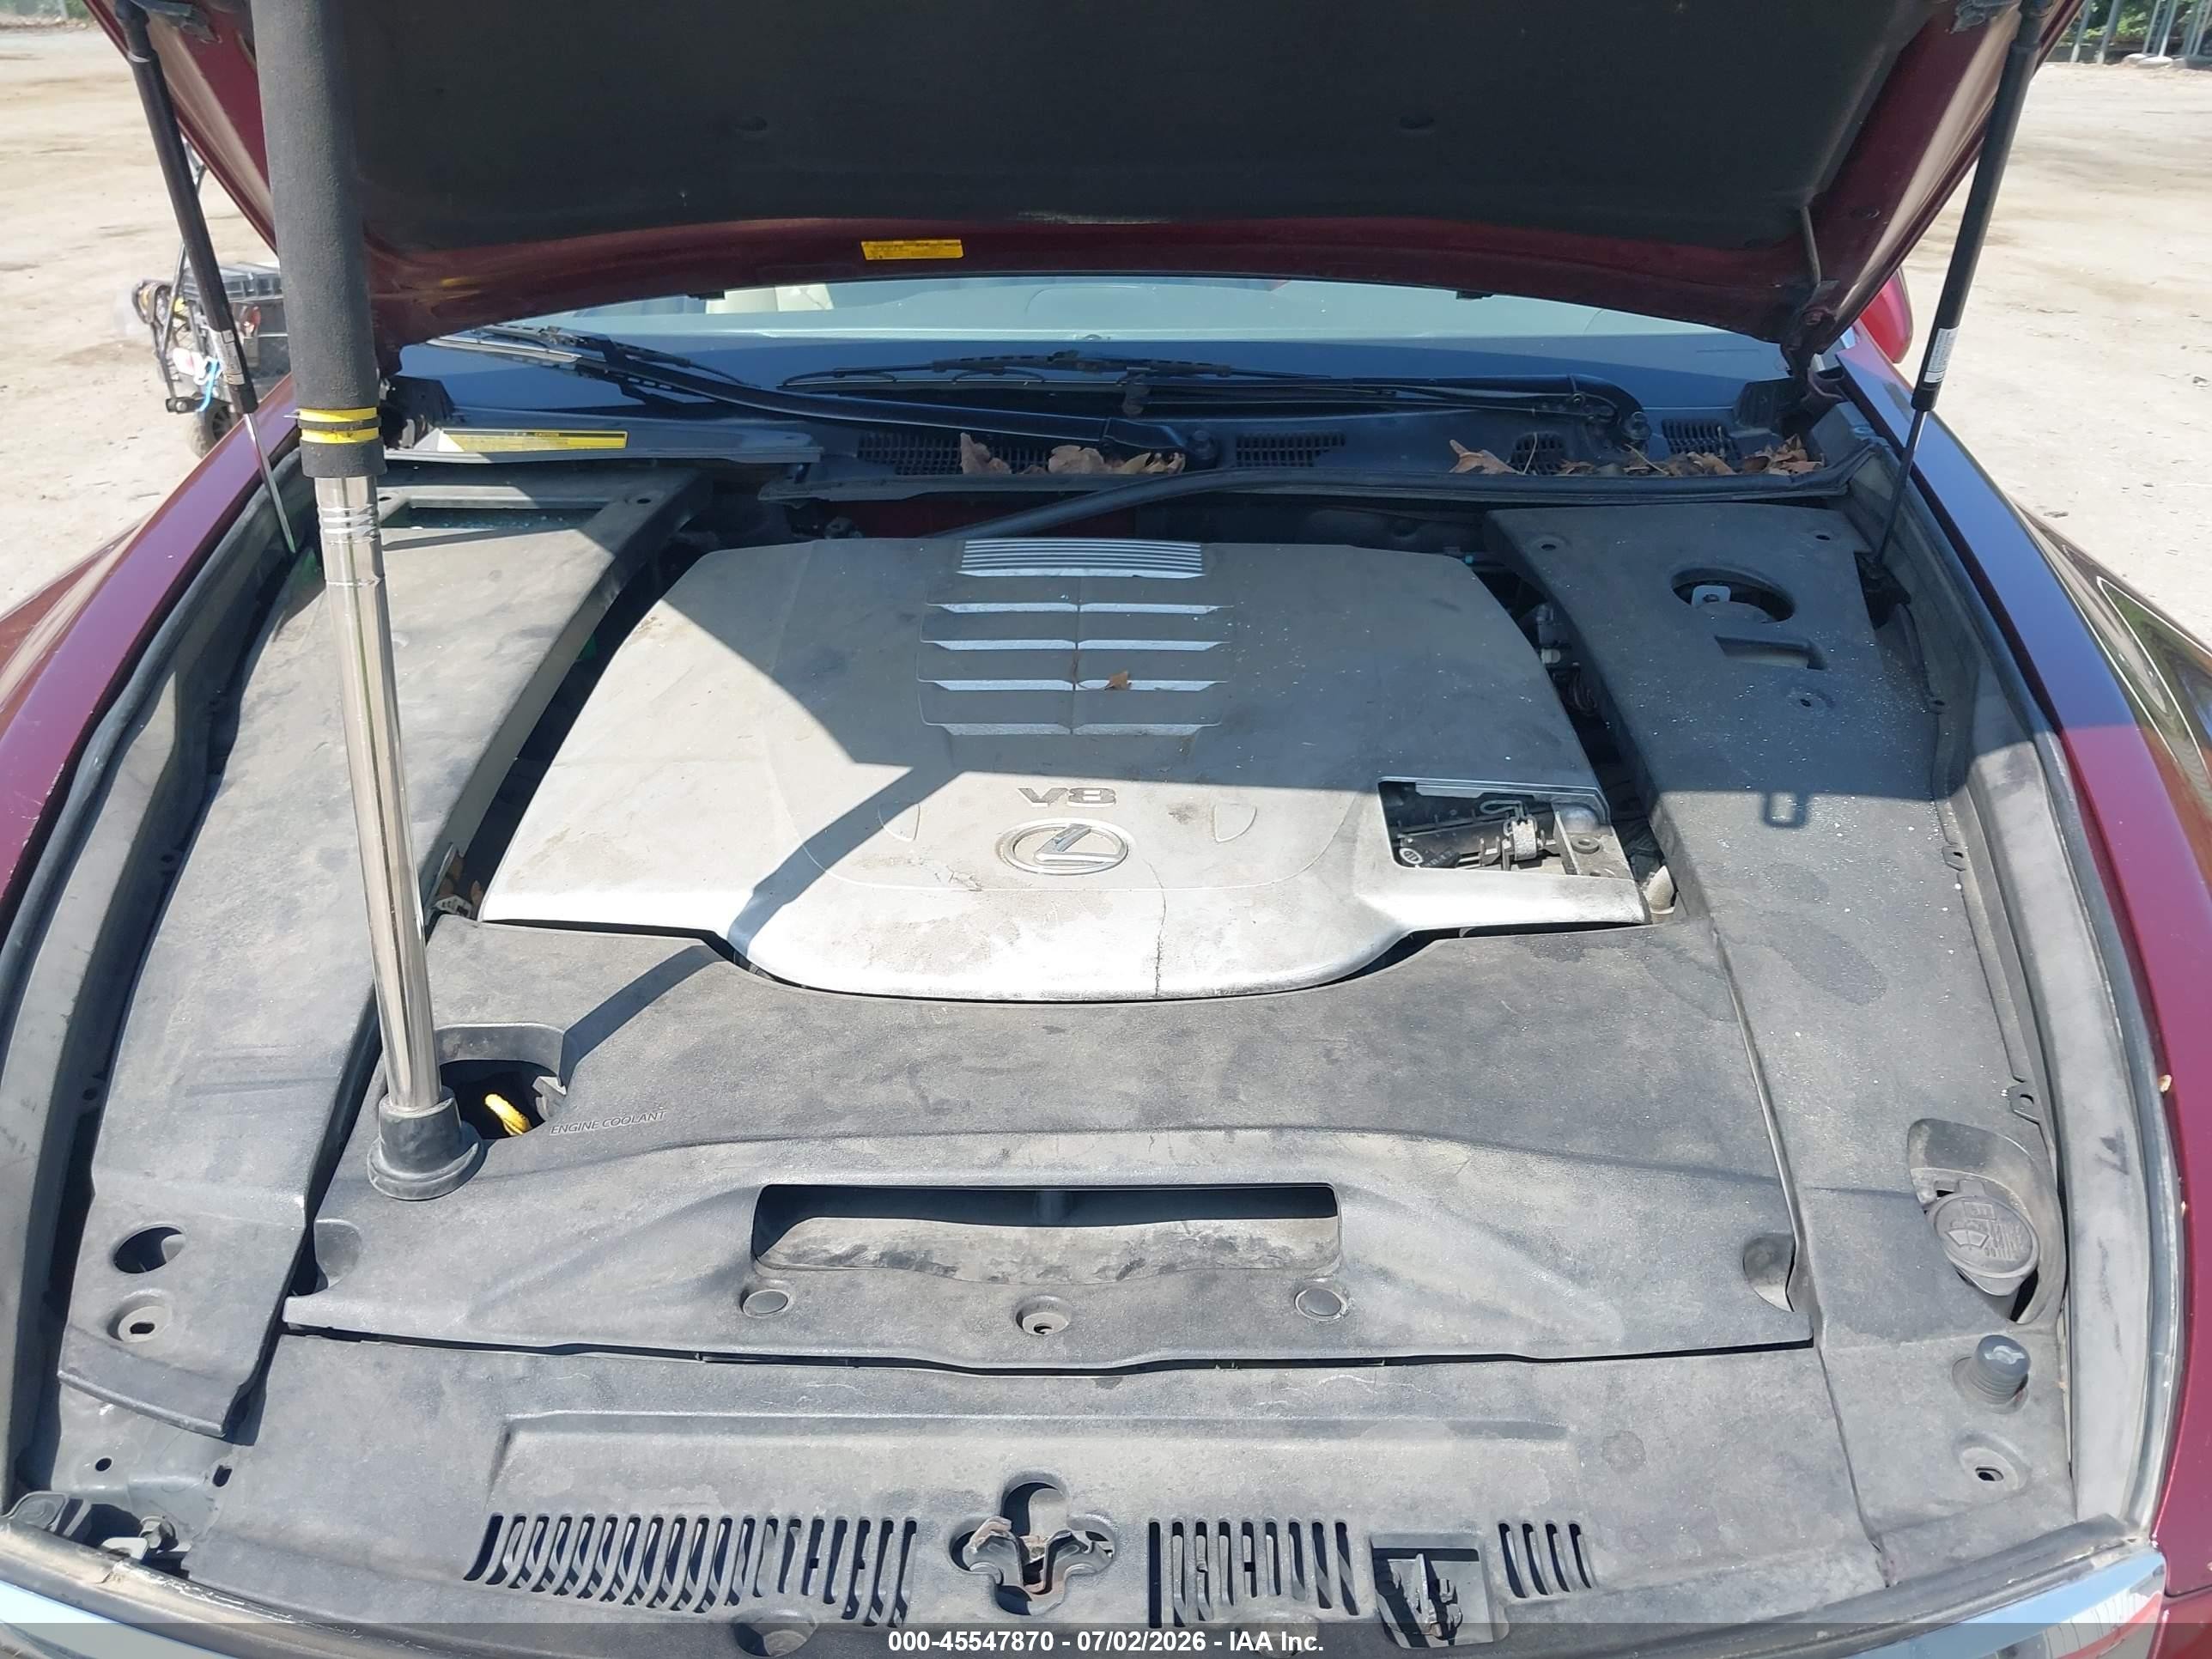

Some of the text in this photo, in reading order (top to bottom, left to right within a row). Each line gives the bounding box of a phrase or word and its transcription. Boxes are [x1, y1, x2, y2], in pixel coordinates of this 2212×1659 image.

[1018, 787, 1116, 807] V8
[550, 1111, 666, 1135] ENGINE COOLANT
